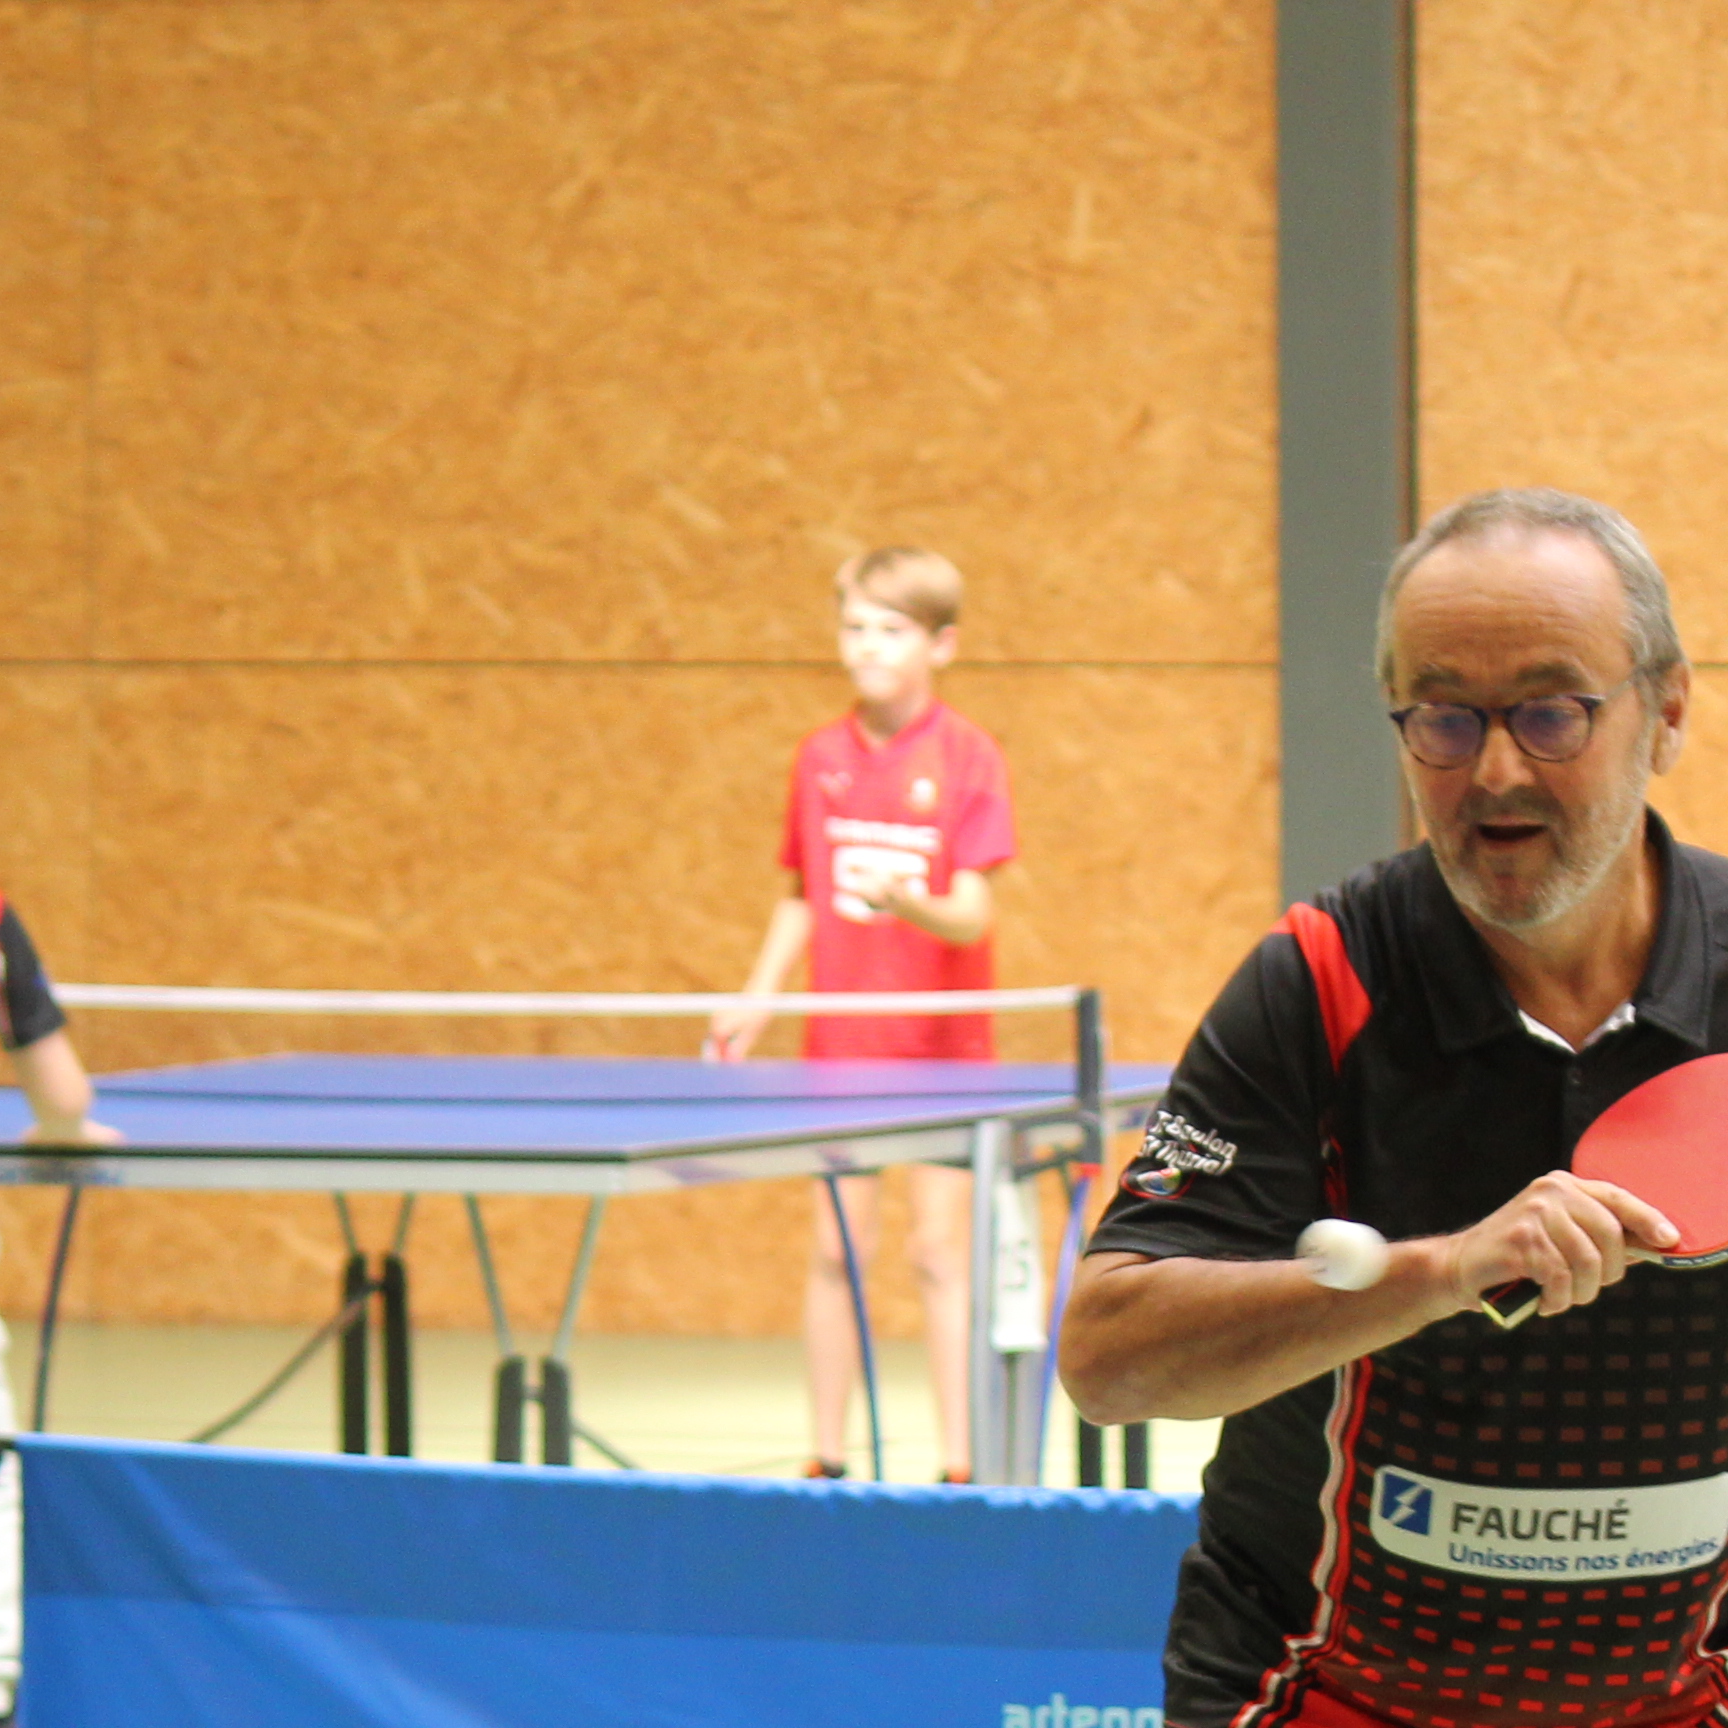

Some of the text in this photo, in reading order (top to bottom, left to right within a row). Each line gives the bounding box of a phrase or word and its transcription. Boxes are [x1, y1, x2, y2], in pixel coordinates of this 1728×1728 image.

[1451, 1499, 1630, 1541] FAUCHÉ
[1448, 1542, 1569, 1571] Unissons
[1574, 1553, 1620, 1571] nos
